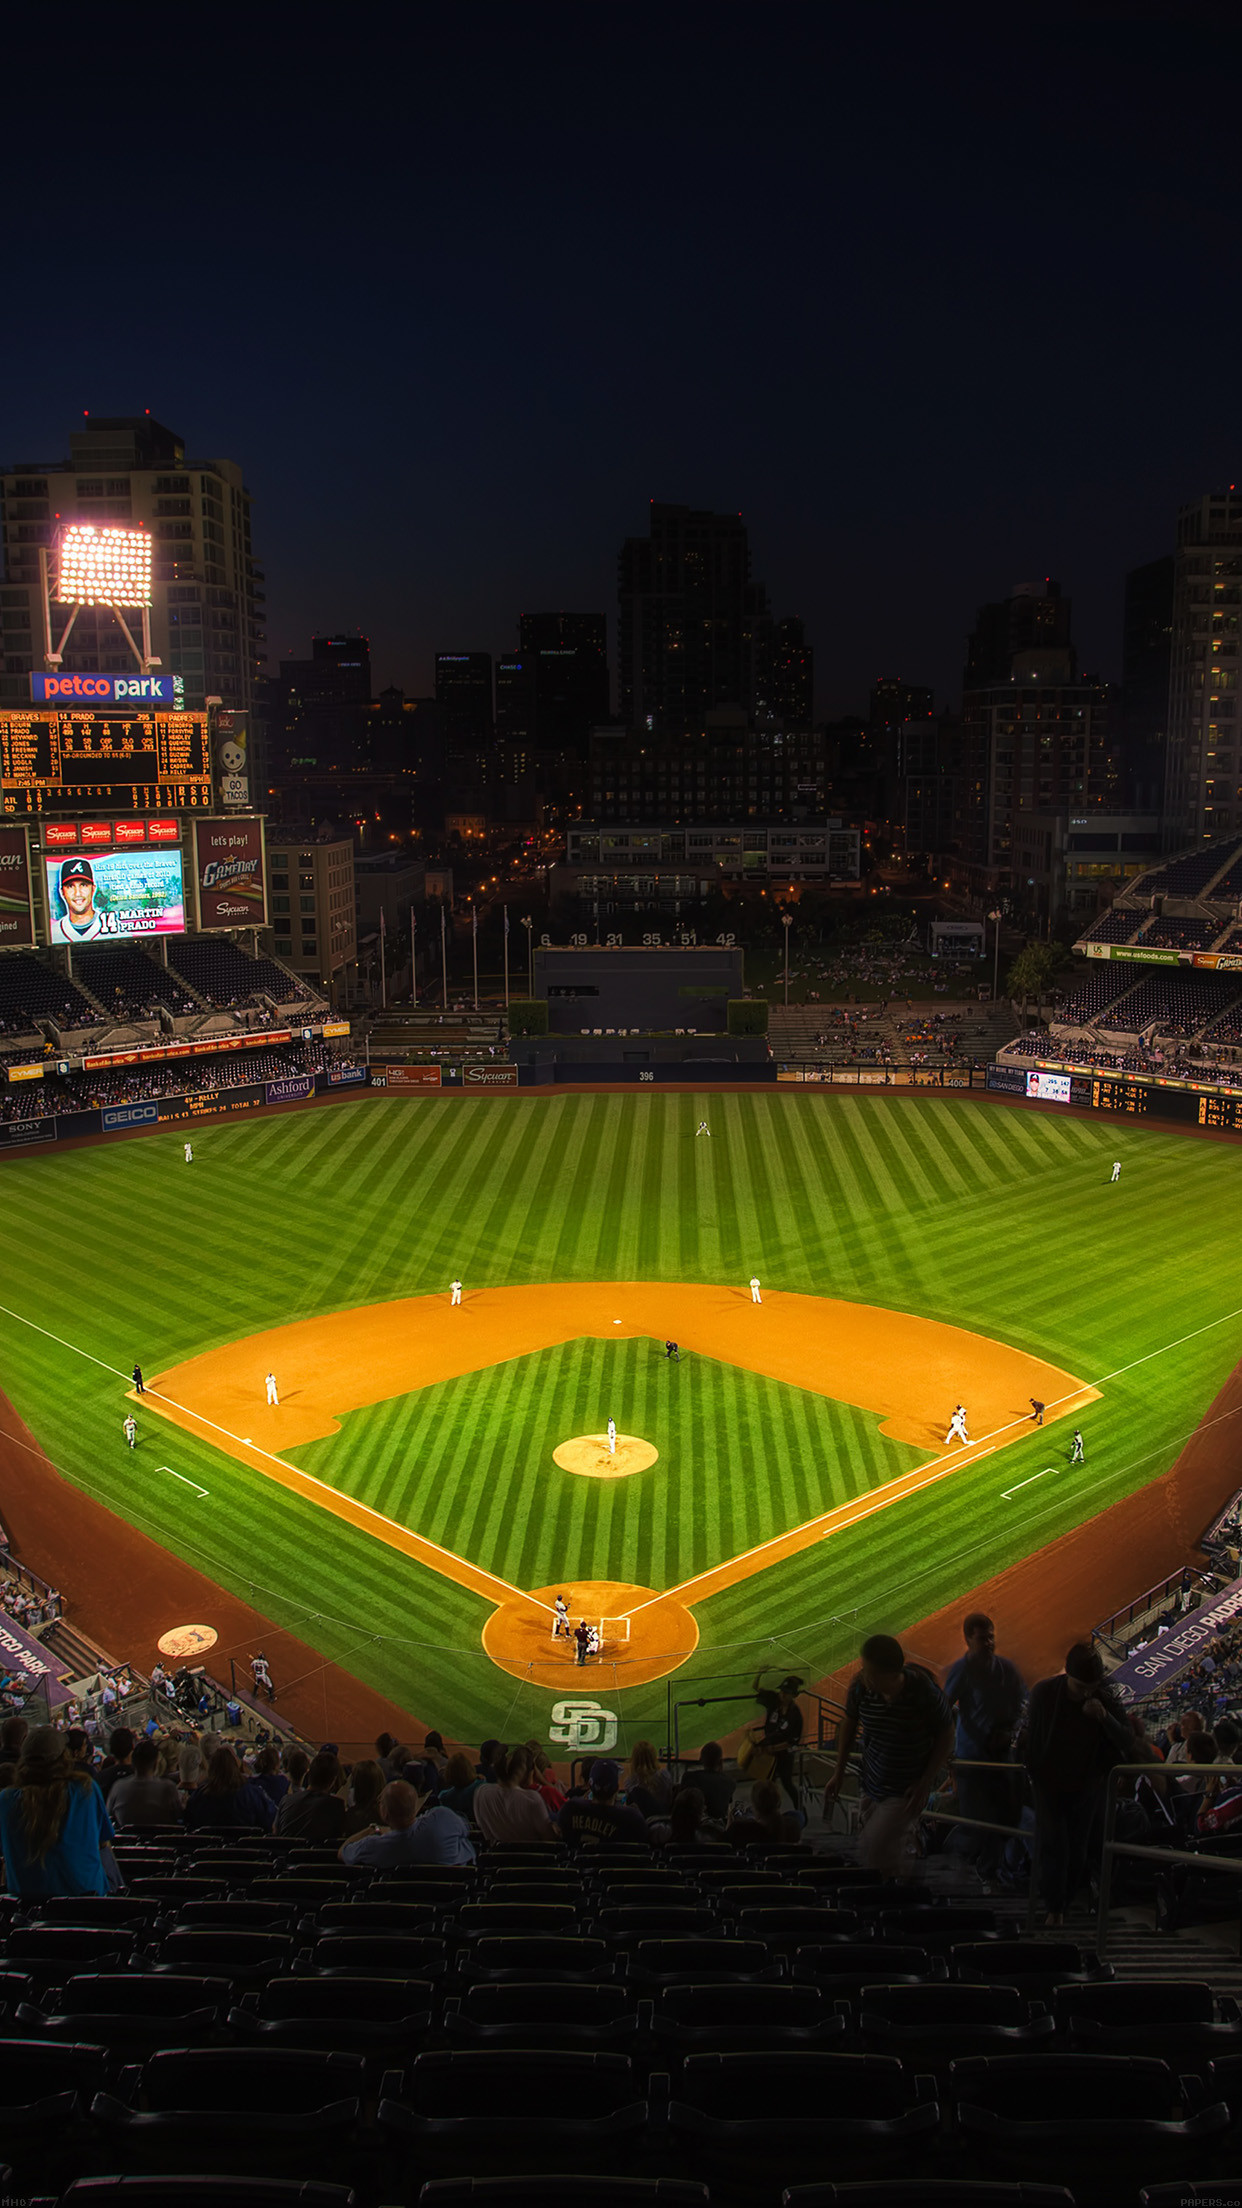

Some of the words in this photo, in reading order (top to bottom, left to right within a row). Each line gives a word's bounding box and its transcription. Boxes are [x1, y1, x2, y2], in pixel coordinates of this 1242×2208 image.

[44, 676, 110, 699] petco
[114, 677, 163, 700] park
[178, 786, 186, 794] B
[190, 786, 197, 794] S
[230, 780, 242, 790] GO
[180, 796, 185, 806] 1
[191, 796, 197, 806] 0
[202, 796, 208, 805] 0
[226, 791, 248, 800] TACOS
[46, 828, 76, 840] Sycuan
[82, 826, 112, 838] Sycuan
[116, 824, 145, 837] Sycuan
[149, 824, 177, 836] Sycuan
[210, 836, 227, 846] let's
[228, 834, 248, 848] play!
[120, 908, 164, 920] MARTIN
[216, 902, 250, 916] Sycuan
[100, 912, 118, 934] 14
[120, 920, 156, 932] PRADO
[540, 933, 551, 946] 6
[570, 933, 588, 946] 19
[606, 933, 623, 946] 31
[642, 933, 662, 946] 35
[681, 933, 698, 946] 51
[716, 933, 736, 946] 42
[1116, 951, 1174, 962] www.usfoods.com
[324, 1026, 349, 1036] CYMER
[10, 1068, 43, 1078] CYMER
[468, 1068, 512, 1084] Sycuan
[640, 1072, 654, 1081] 396
[269, 1078, 310, 1096] Ashford
[370, 1078, 386, 1086] 401
[948, 1080, 964, 1088] 400
[996, 1081, 1008, 1090] SAN
[1008, 1083, 1024, 1092] DIEGO
[198, 1092, 220, 1102] KELLY
[231, 1102, 250, 1110] TOTAL
[104, 1106, 156, 1124] GEICO
[9, 1121, 42, 1133] SONY
[1134, 1652, 1174, 1678] SAN
[1163, 1625, 1210, 1656] DIEGO
[1199, 1588, 1242, 1628] PADRE
[14, 1650, 52, 1675] PARK
[549, 1700, 618, 1752] SD
[572, 1815, 617, 1838] HEADLEY
